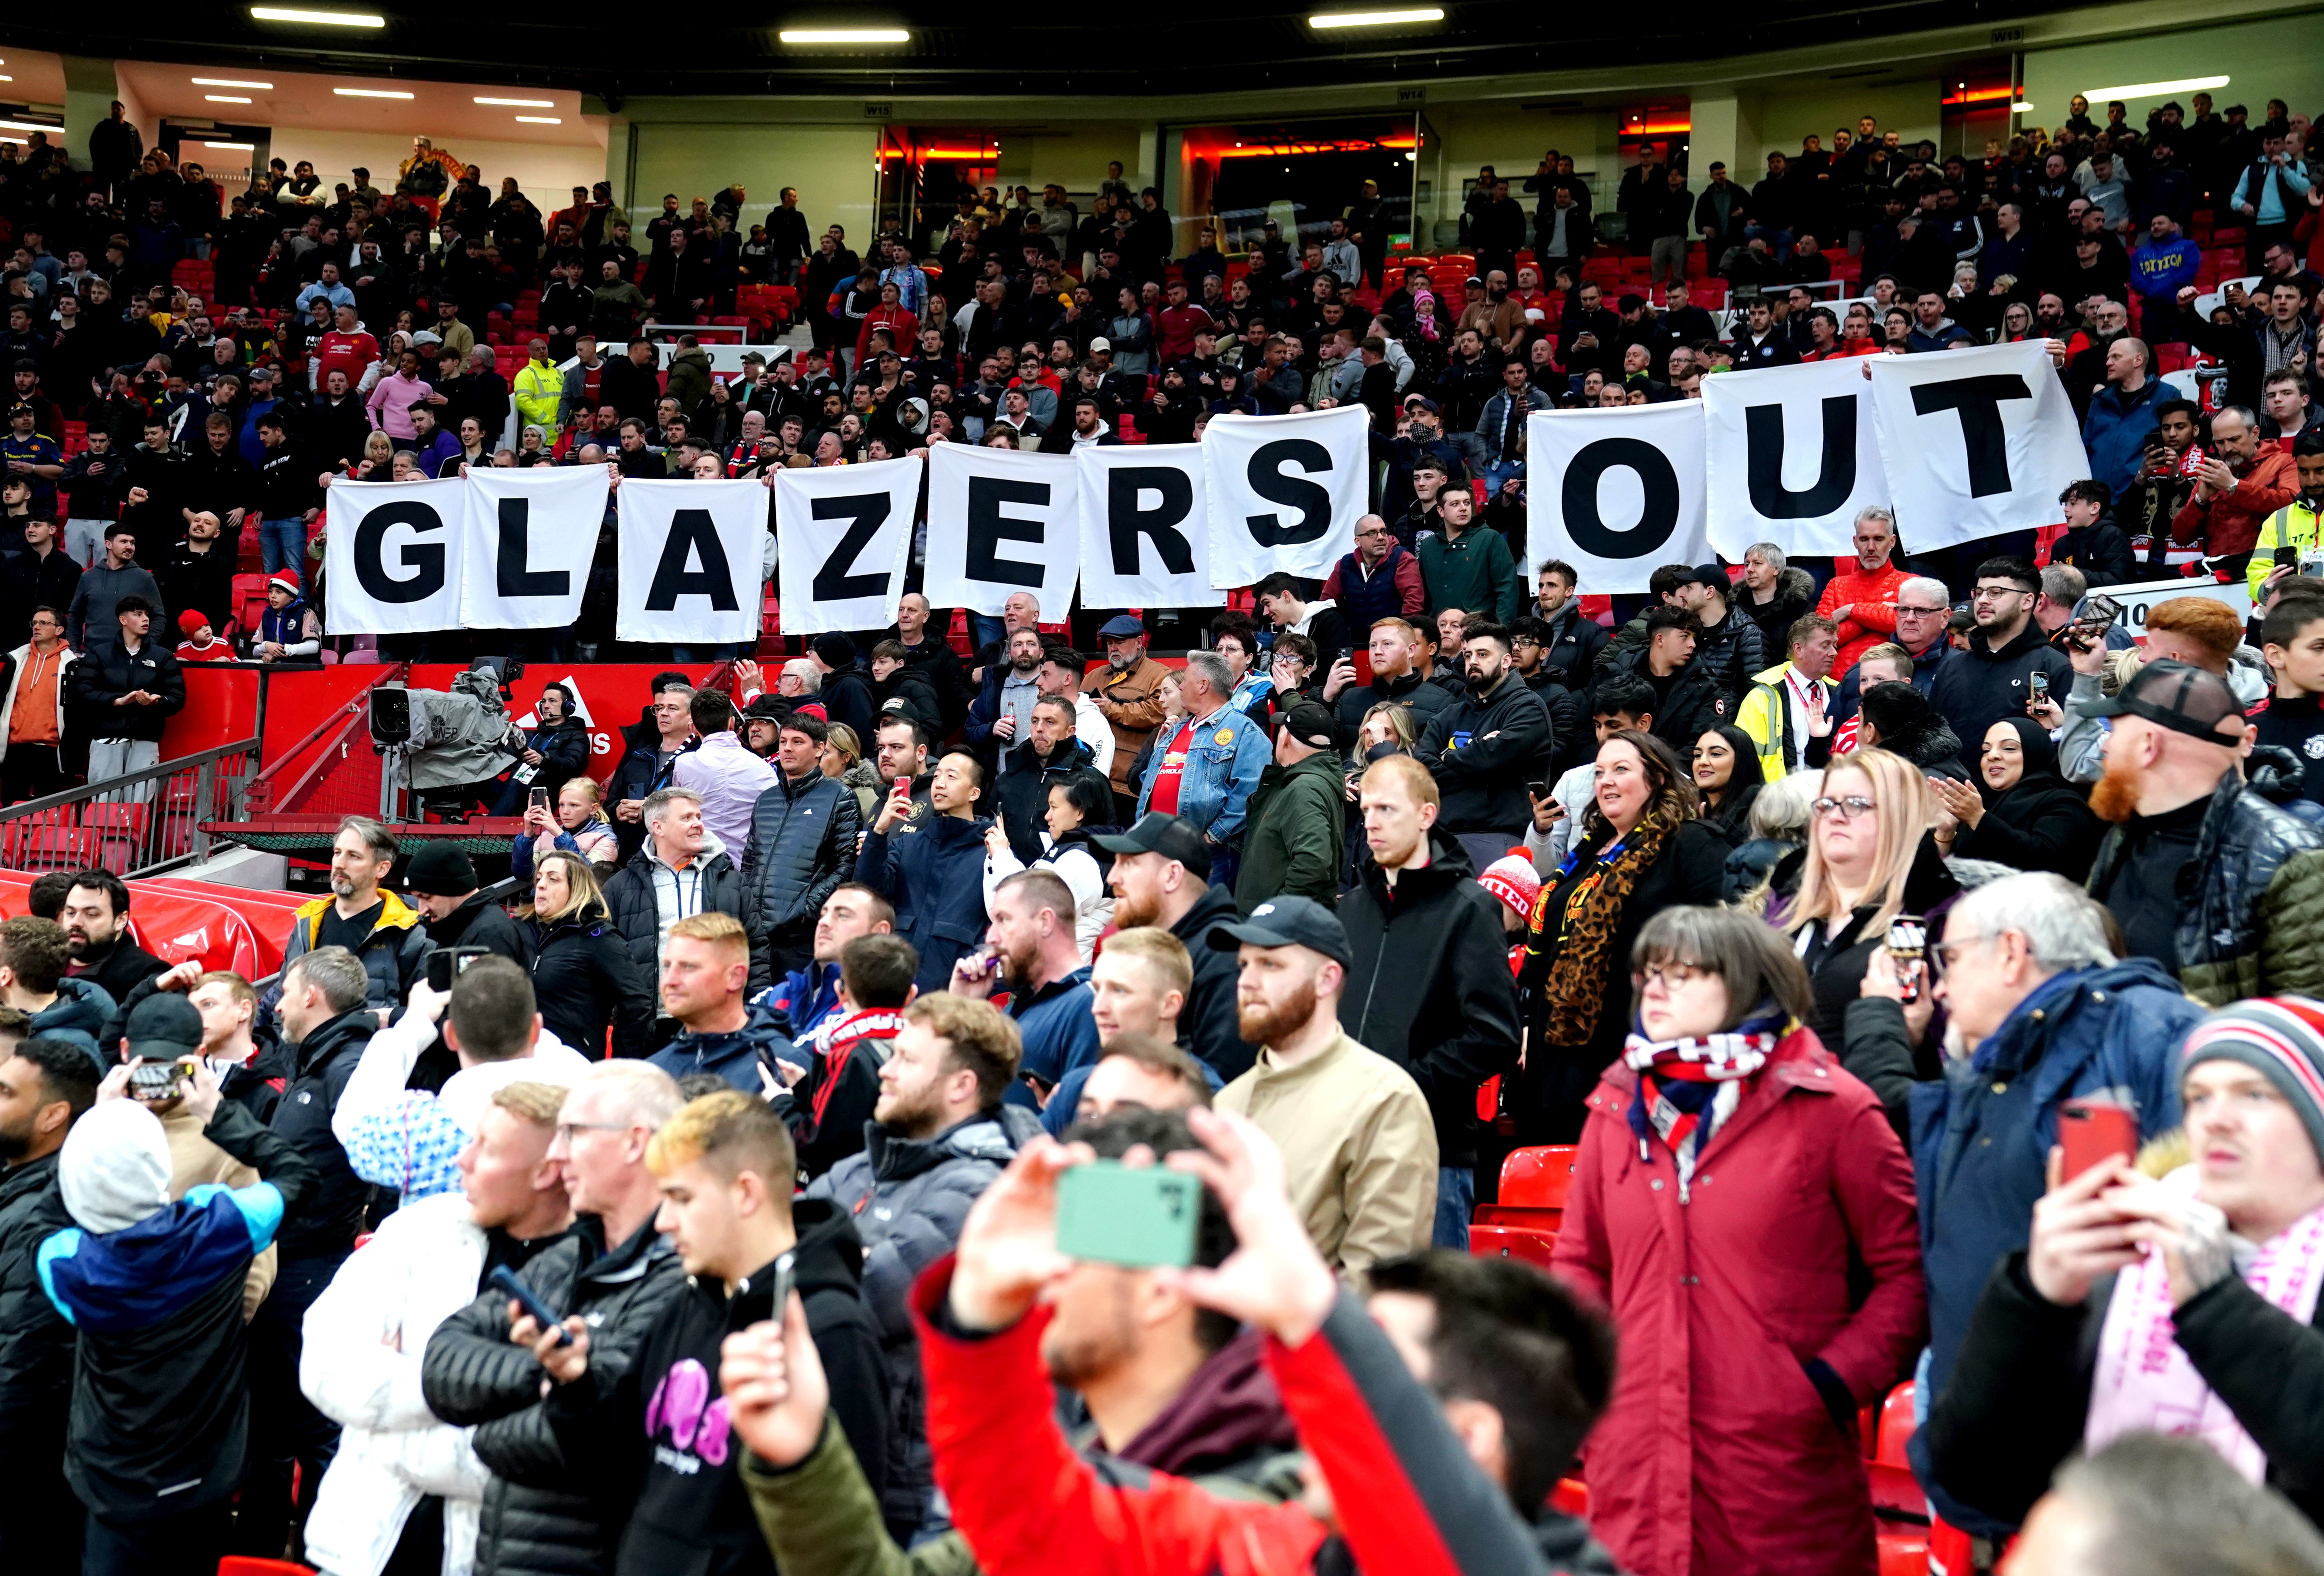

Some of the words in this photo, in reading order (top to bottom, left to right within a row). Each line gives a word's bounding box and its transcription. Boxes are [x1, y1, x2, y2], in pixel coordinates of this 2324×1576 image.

[1400, 91, 1423, 100] W14
[354, 439, 1333, 611] GLAZERS
[1562, 374, 2032, 558] OUT
[439, 727, 457, 739] NEP
[899, 824, 917, 833] AON
